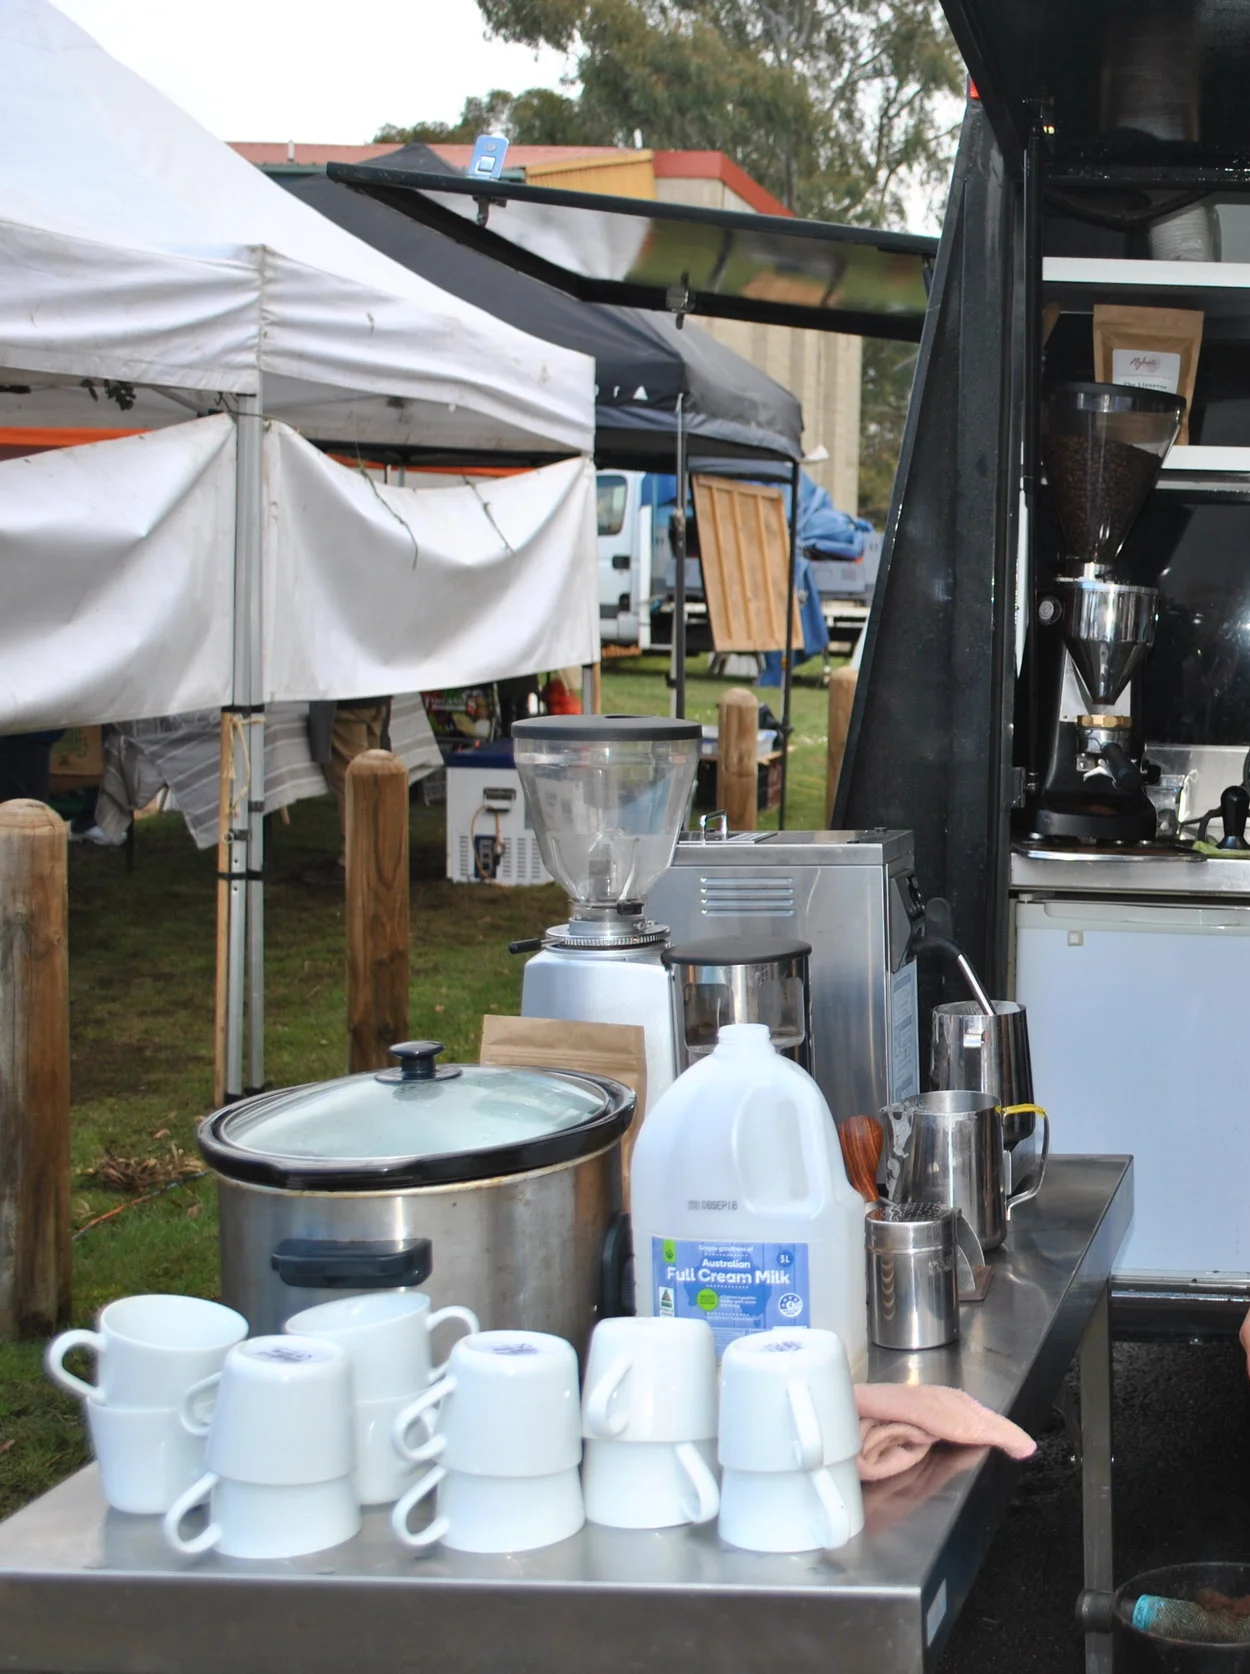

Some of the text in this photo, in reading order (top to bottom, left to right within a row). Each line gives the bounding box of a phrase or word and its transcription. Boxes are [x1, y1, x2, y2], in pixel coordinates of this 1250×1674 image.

[702, 1258, 751, 1269] Australian
[666, 1266, 791, 1285] Full Cream Milk
